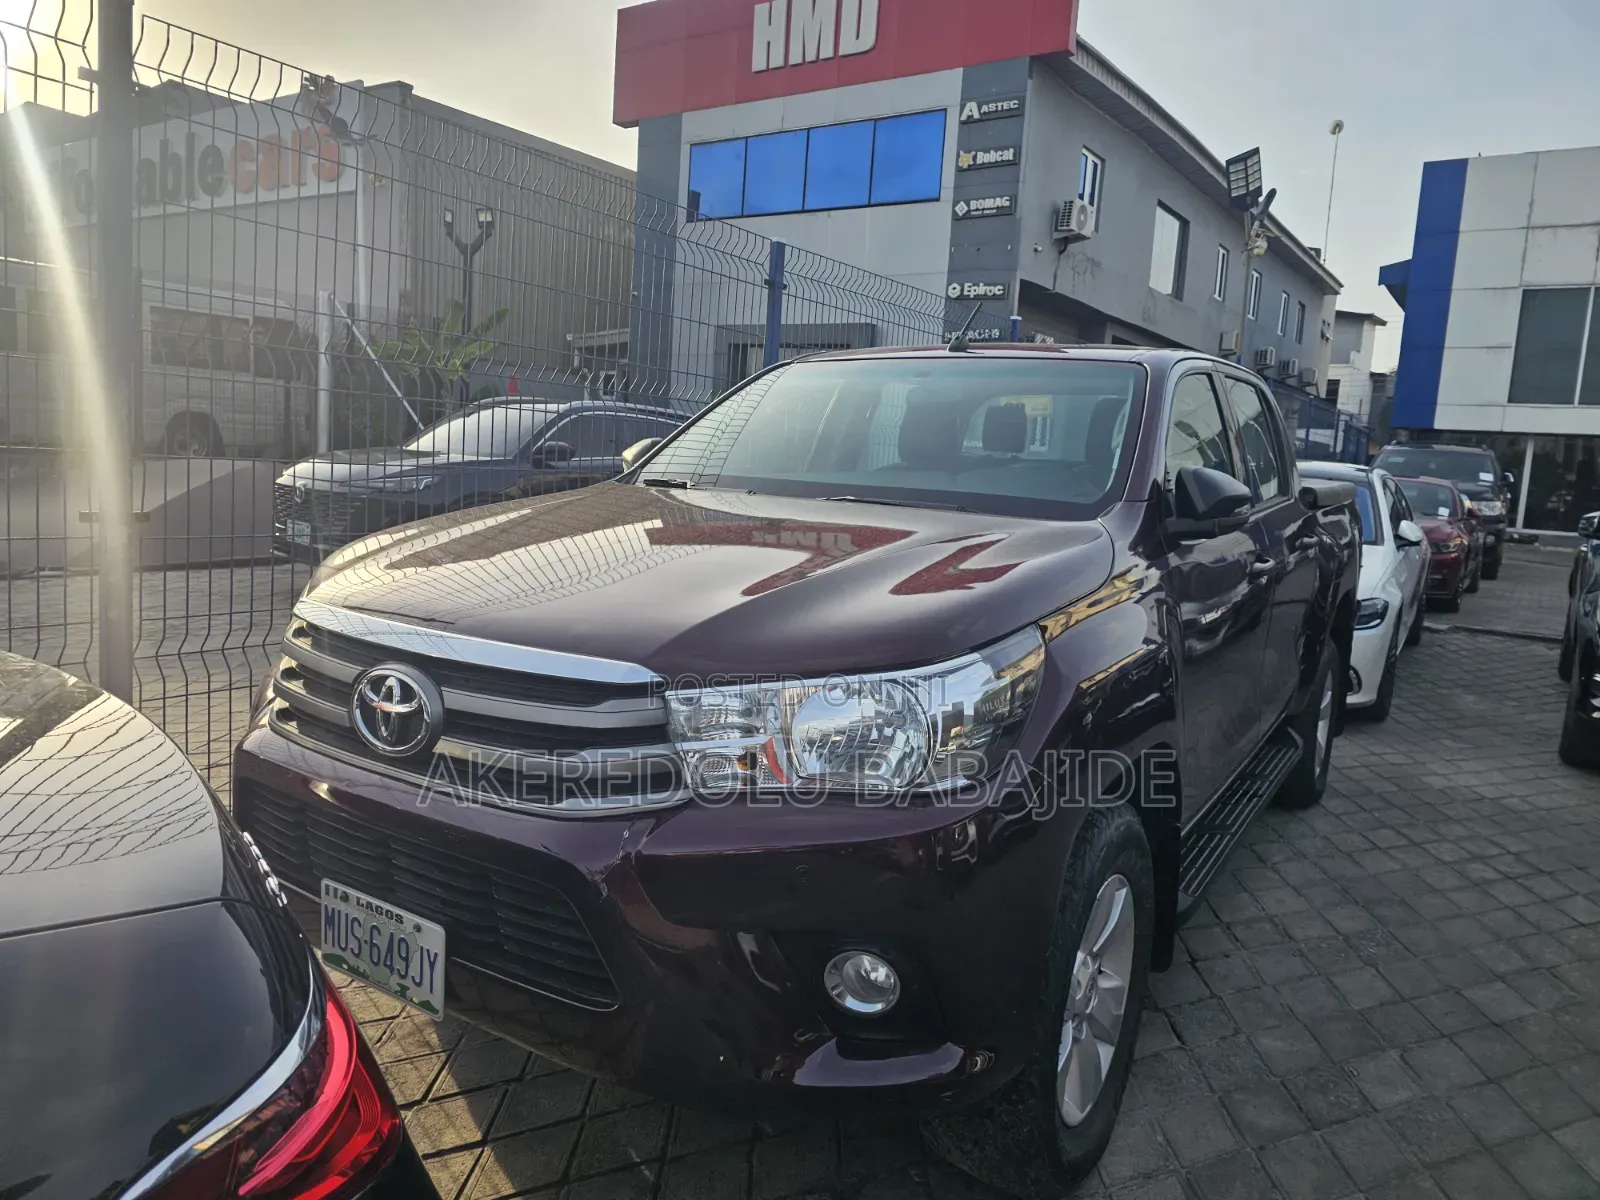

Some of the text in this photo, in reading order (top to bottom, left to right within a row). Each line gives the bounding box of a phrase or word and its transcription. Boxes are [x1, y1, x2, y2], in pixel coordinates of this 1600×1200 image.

[752, 0, 879, 74] HMD
[980, 100, 1019, 114] ASTEC
[976, 147, 1015, 165] Bobcat
[969, 196, 1011, 211] BOMAG
[963, 282, 1004, 298] Epiroc
[355, 896, 404, 925] LAGOS
[324, 904, 438, 994] MUS-649JY
